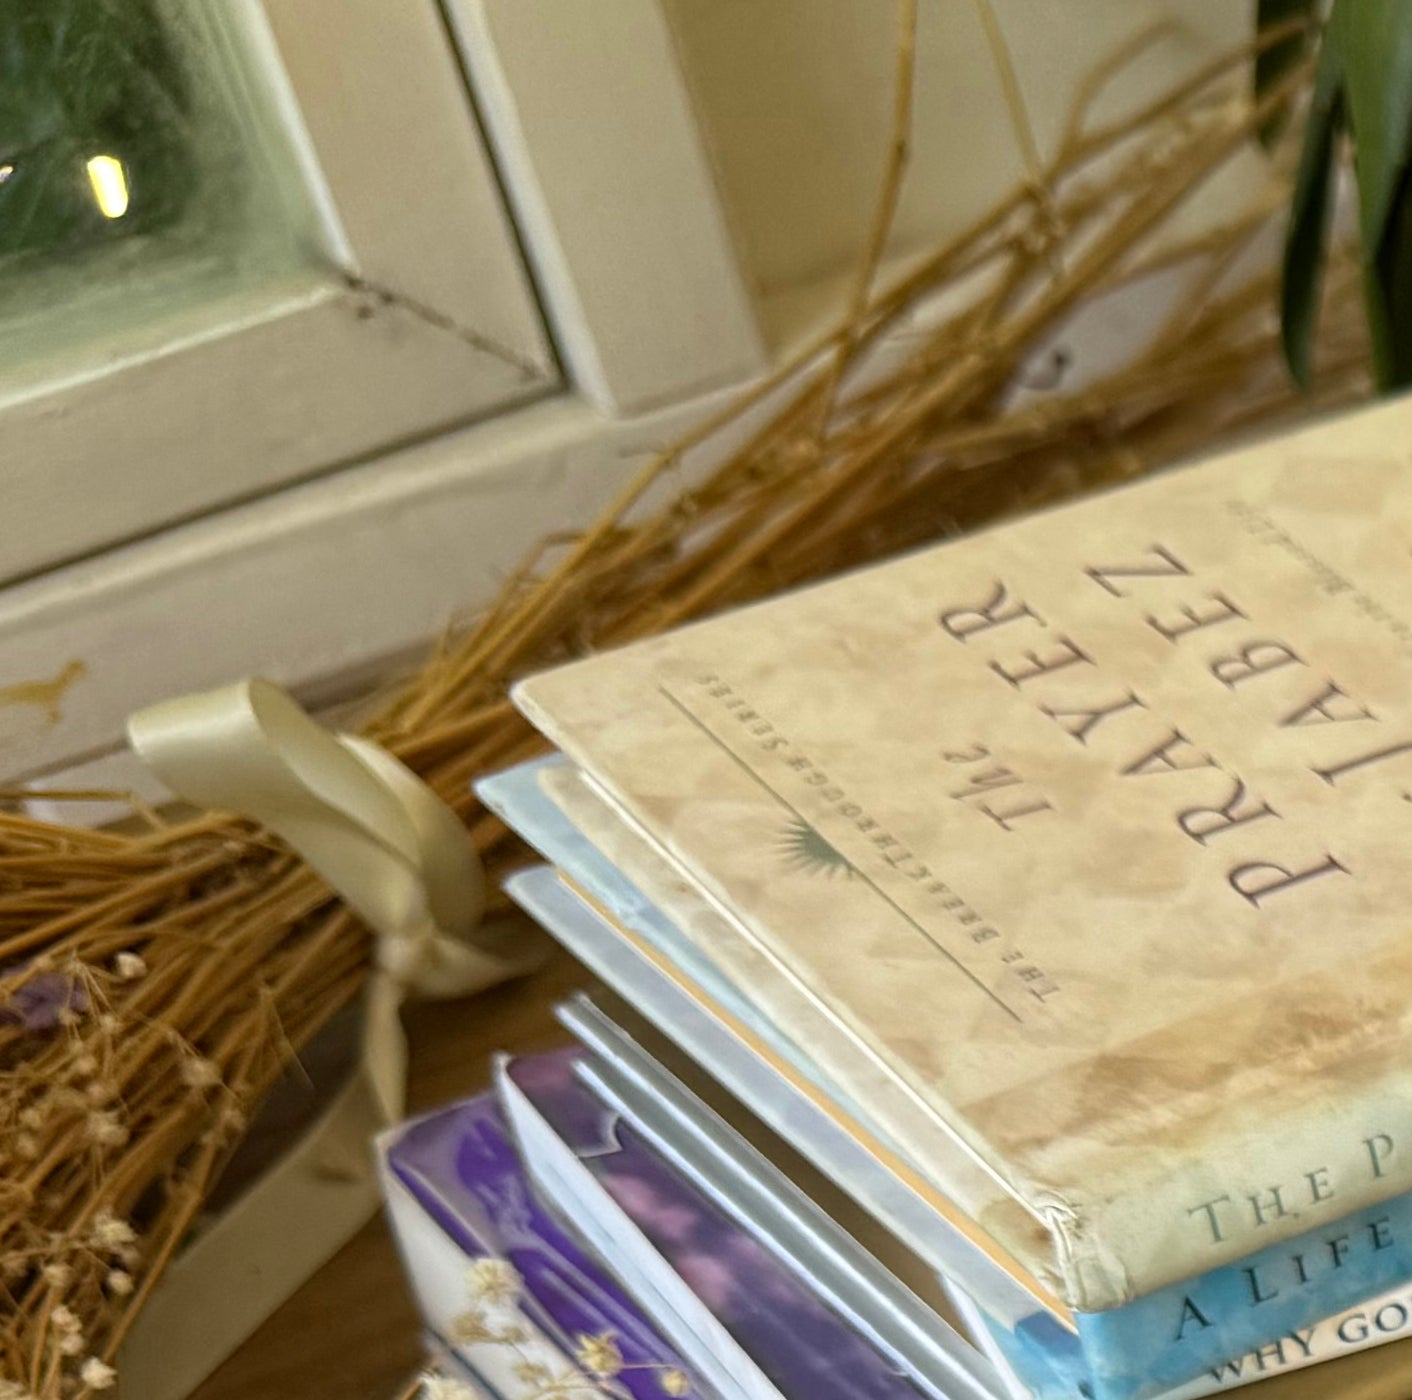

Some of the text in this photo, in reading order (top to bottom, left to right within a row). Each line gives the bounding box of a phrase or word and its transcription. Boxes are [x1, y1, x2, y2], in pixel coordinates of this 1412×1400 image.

[687, 672, 792, 751] SERIES
[930, 578, 1353, 909] PRAYER
[935, 739, 1061, 832] The
[995, 951, 1064, 1003] THE
[1187, 1168, 1334, 1244] THE
[1175, 1294, 1212, 1342] A
[1244, 1217, 1394, 1307] LIFE
[1209, 1327, 1316, 1385] WHY
